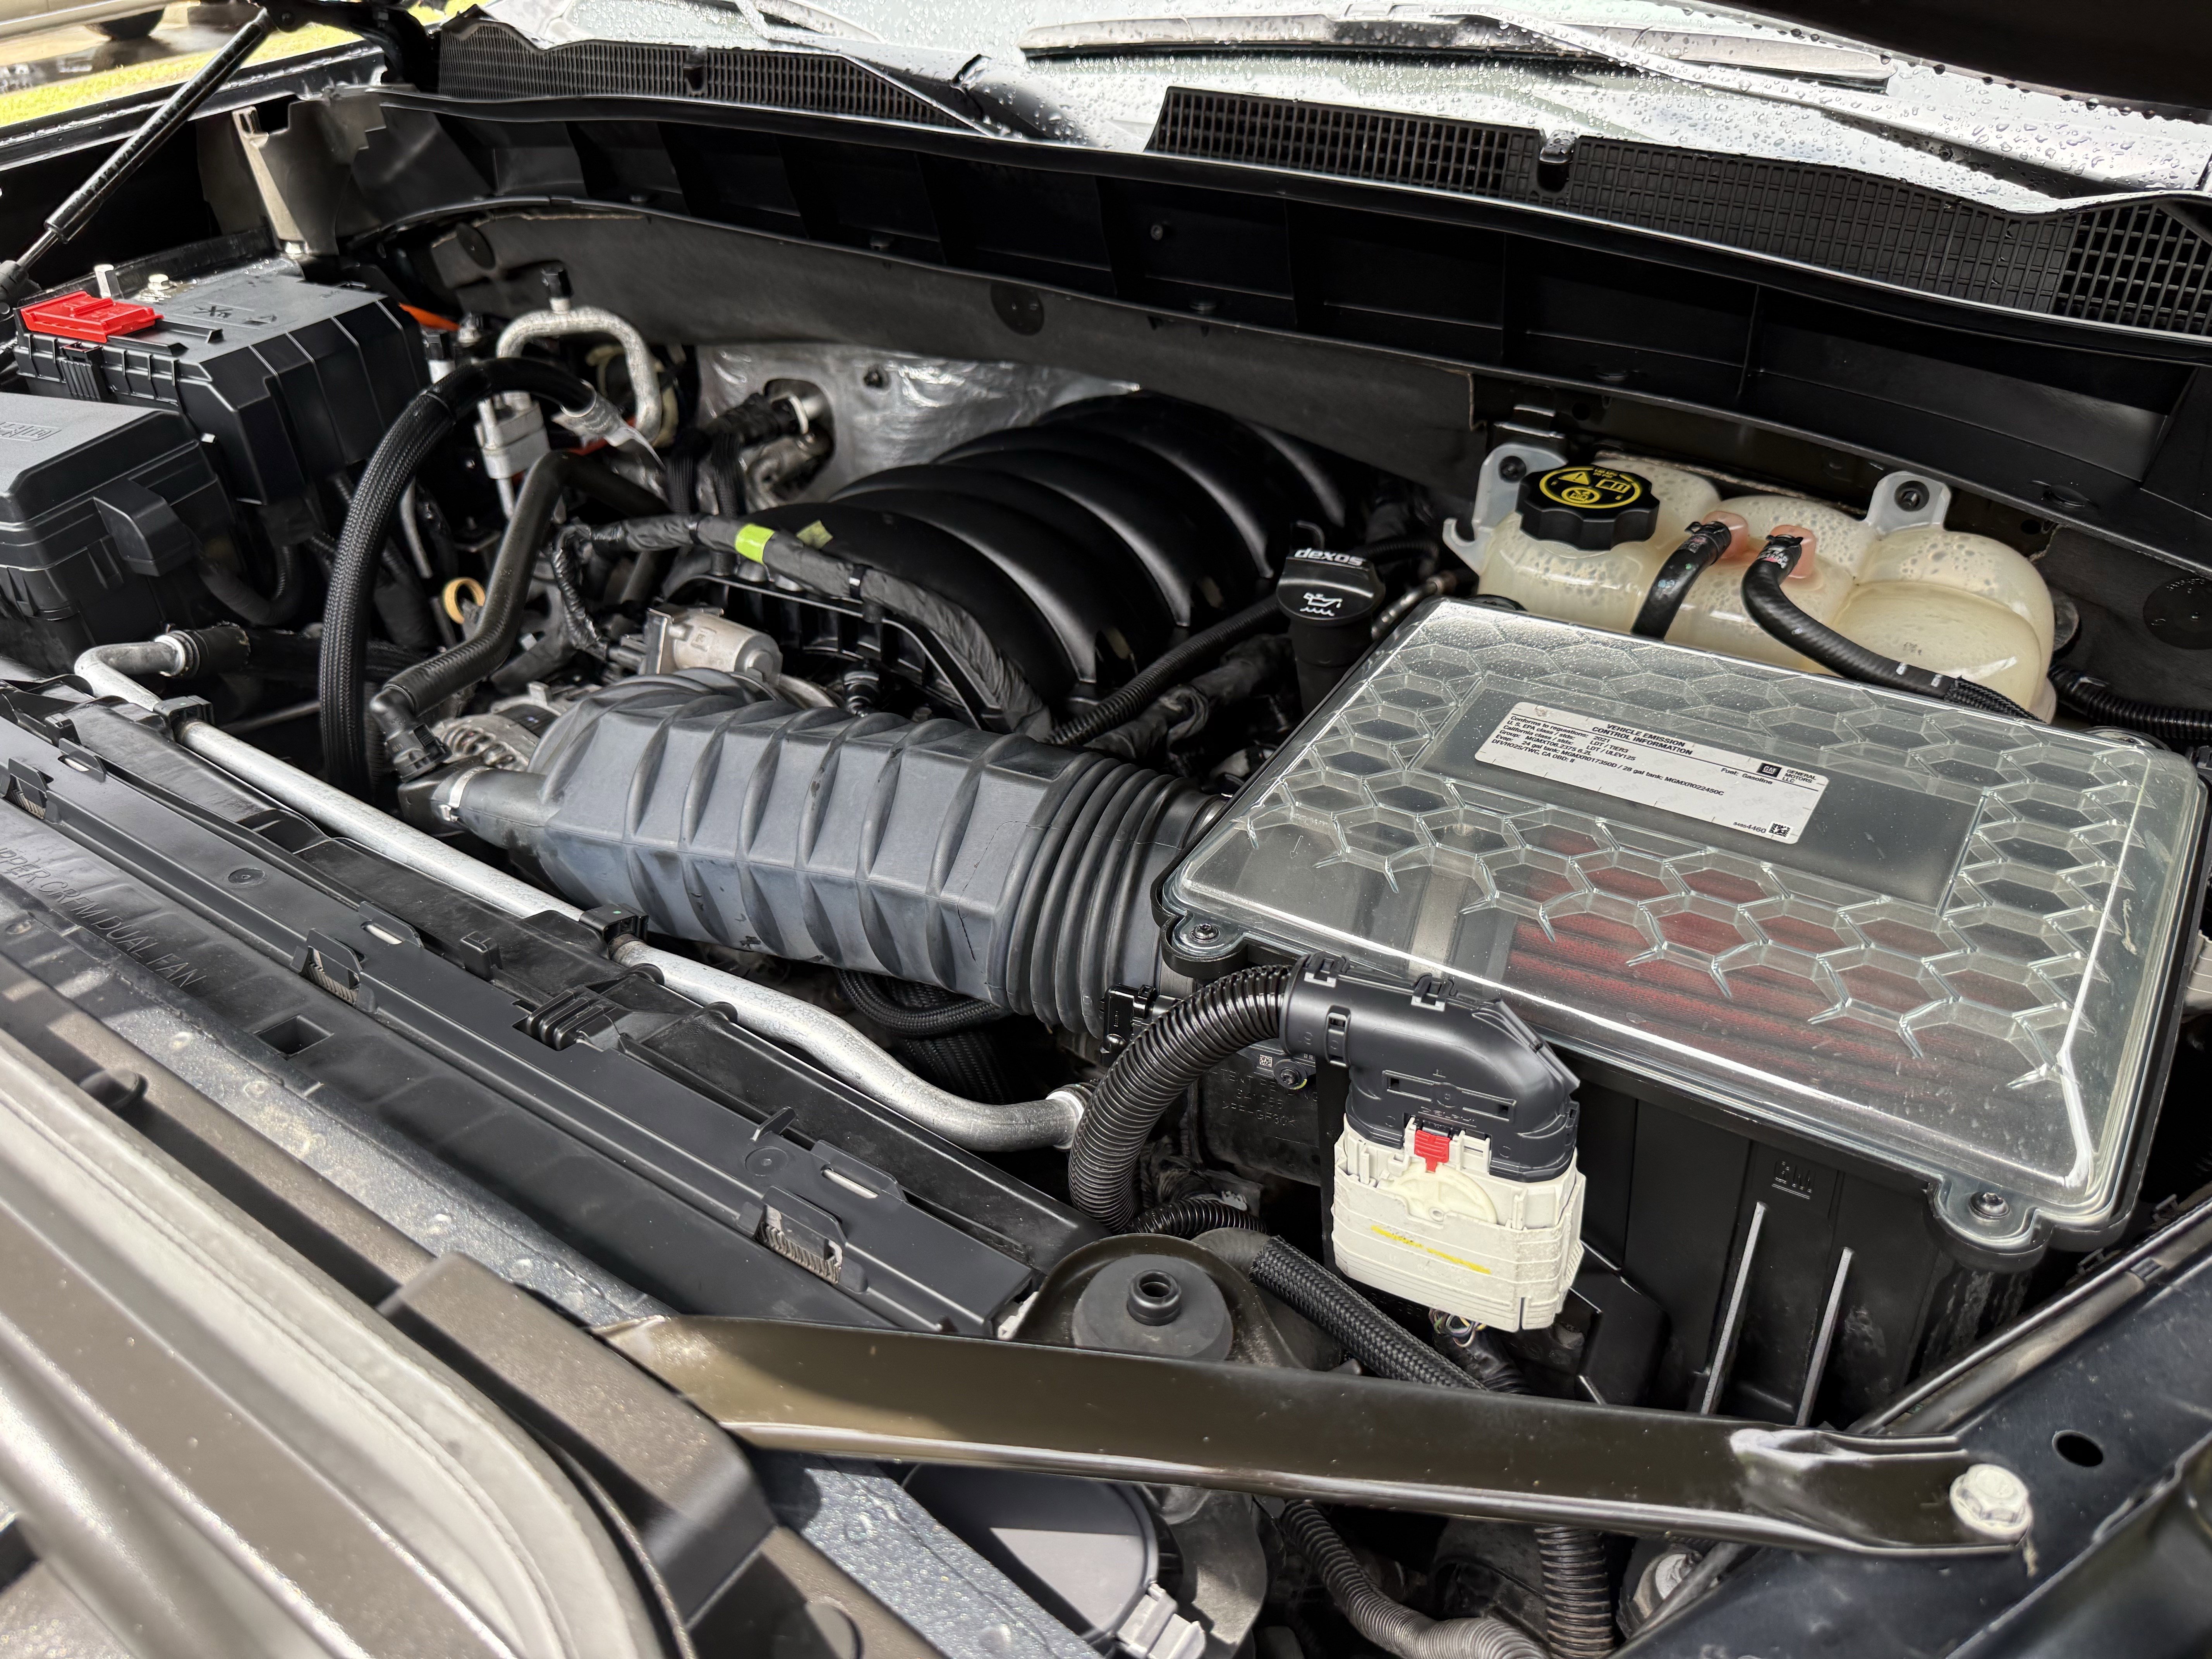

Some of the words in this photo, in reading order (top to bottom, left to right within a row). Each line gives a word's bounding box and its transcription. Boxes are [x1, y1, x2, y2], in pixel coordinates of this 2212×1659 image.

[1293, 547, 1368, 566] dexos
[1510, 716, 1541, 726] Conforms
[1499, 730, 1520, 738] Group:
[1503, 725, 1534, 736] California
[1607, 724, 1641, 736] VEHICLE
[1643, 733, 1686, 747] EMISSION
[1592, 726, 1632, 740] CONTROL
[1633, 737, 1693, 755] INFORMATION
[1543, 746, 1560, 754] tank:
[1609, 744, 1629, 753] TIER3
[1552, 754, 1569, 762] OBD:
[1605, 749, 1637, 761] ULEV125
[1721, 768, 1739, 776] Fuel:
[1741, 773, 1773, 785] Gasoline
[1784, 773, 1813, 783] MOTORS
[1786, 769, 1817, 781] GENERAL
[0, 847, 51, 883] PPER
[38, 881, 109, 919] CRFM
[91, 915, 159, 959] DUAL
[146, 953, 207, 988] FAN
